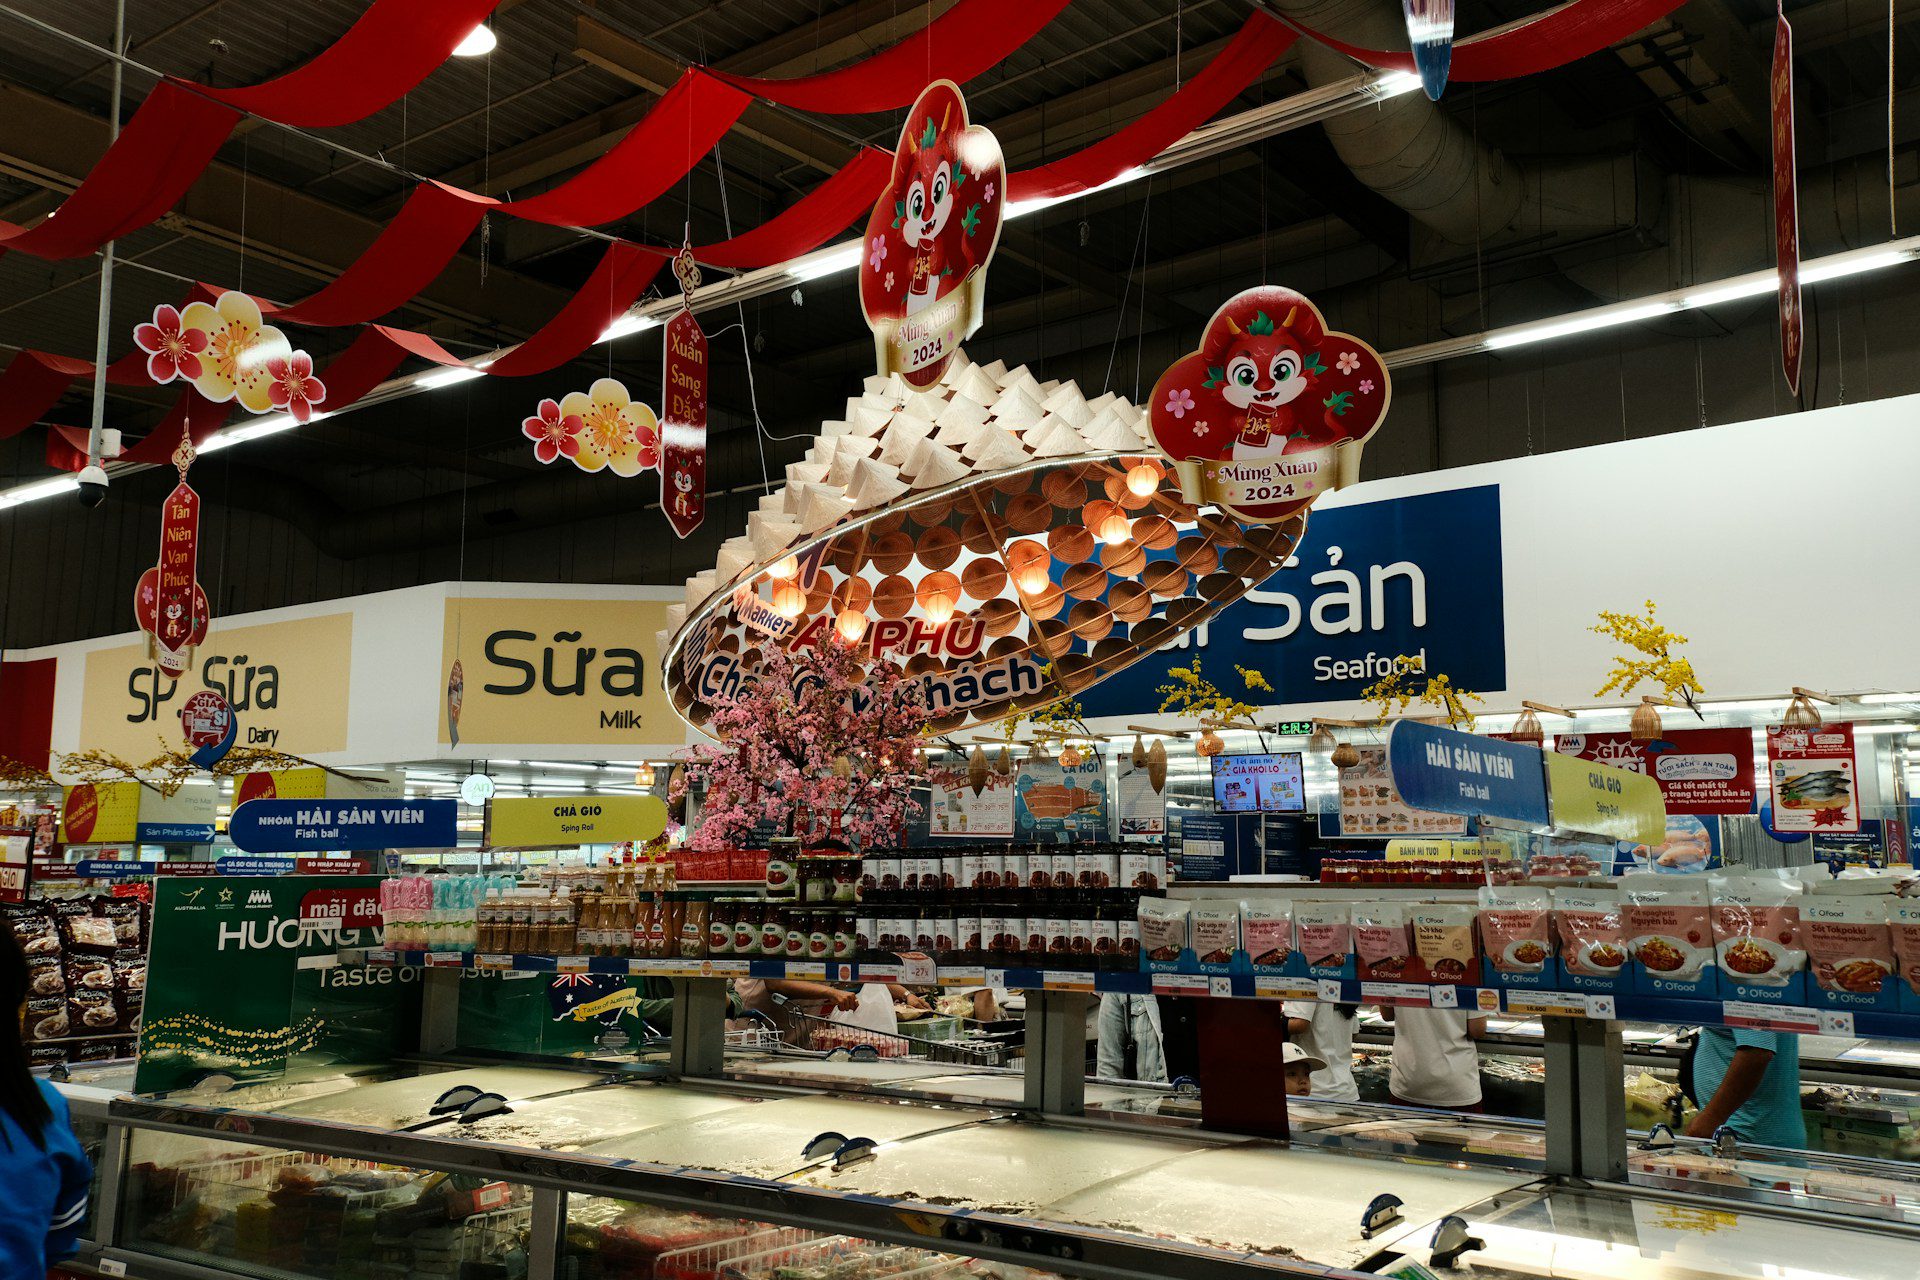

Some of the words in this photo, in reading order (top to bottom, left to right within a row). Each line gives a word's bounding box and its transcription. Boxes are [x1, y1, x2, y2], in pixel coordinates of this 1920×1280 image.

[671, 332, 703, 365] Xuân
[913, 337, 943, 366] 2024
[671, 364, 701, 399] Sang
[673, 395, 698, 422] Đắc
[1218, 462, 1272, 484] Mừng
[1274, 459, 1318, 479] Xuân
[1245, 483, 1295, 501] 2024
[172, 504, 191, 520] Tân
[166, 527, 192, 542] Niên
[167, 550, 188, 568] Vạn
[163, 571, 190, 588] Phúc
[871, 610, 986, 658] PHÚ
[163, 656, 179, 668] 2024
[484, 630, 644, 697] Sữa
[1313, 648, 1427, 682] Seafood
[600, 710, 642, 730] Milk
[248, 727, 279, 748] Dairy
[1425, 738, 1452, 769] HẢI
[1454, 743, 1482, 774] SẢN
[1483, 752, 1515, 780] VIÊN
[1715, 762, 1735, 772] TOÀN
[365, 784, 381, 793] Sữa
[382, 785, 399, 793] Chua
[1588, 771, 1605, 791] CHẢ
[1668, 782, 1682, 790] Giá
[1683, 781, 1696, 790] tốt
[1697, 781, 1717, 789] nhất
[1459, 782, 1476, 798] Fish
[1476, 785, 1490, 800] ball
[1669, 790, 1692, 799] trang
[1693, 789, 1708, 799] trại
[1722, 788, 1738, 797] bàn
[1740, 789, 1751, 797] ăn
[296, 807, 331, 826] HẢI
[337, 806, 376, 825] SẢN
[381, 807, 425, 825] VIÊN
[553, 803, 577, 817] CHẢ
[580, 803, 602, 816] GIÒ
[146, 828, 161, 836] Sản
[295, 829, 318, 838] Fish
[321, 828, 339, 838] ball
[561, 824, 580, 834] Sping
[310, 898, 346, 918] mãi
[1642, 909, 1675, 918] spaghetti
[1662, 917, 1678, 926] bản
[1811, 924, 1824, 933] Sốt
[1825, 925, 1867, 936] Tokpokki
[315, 966, 393, 988] Taste
[582, 1004, 602, 1014] Taste
